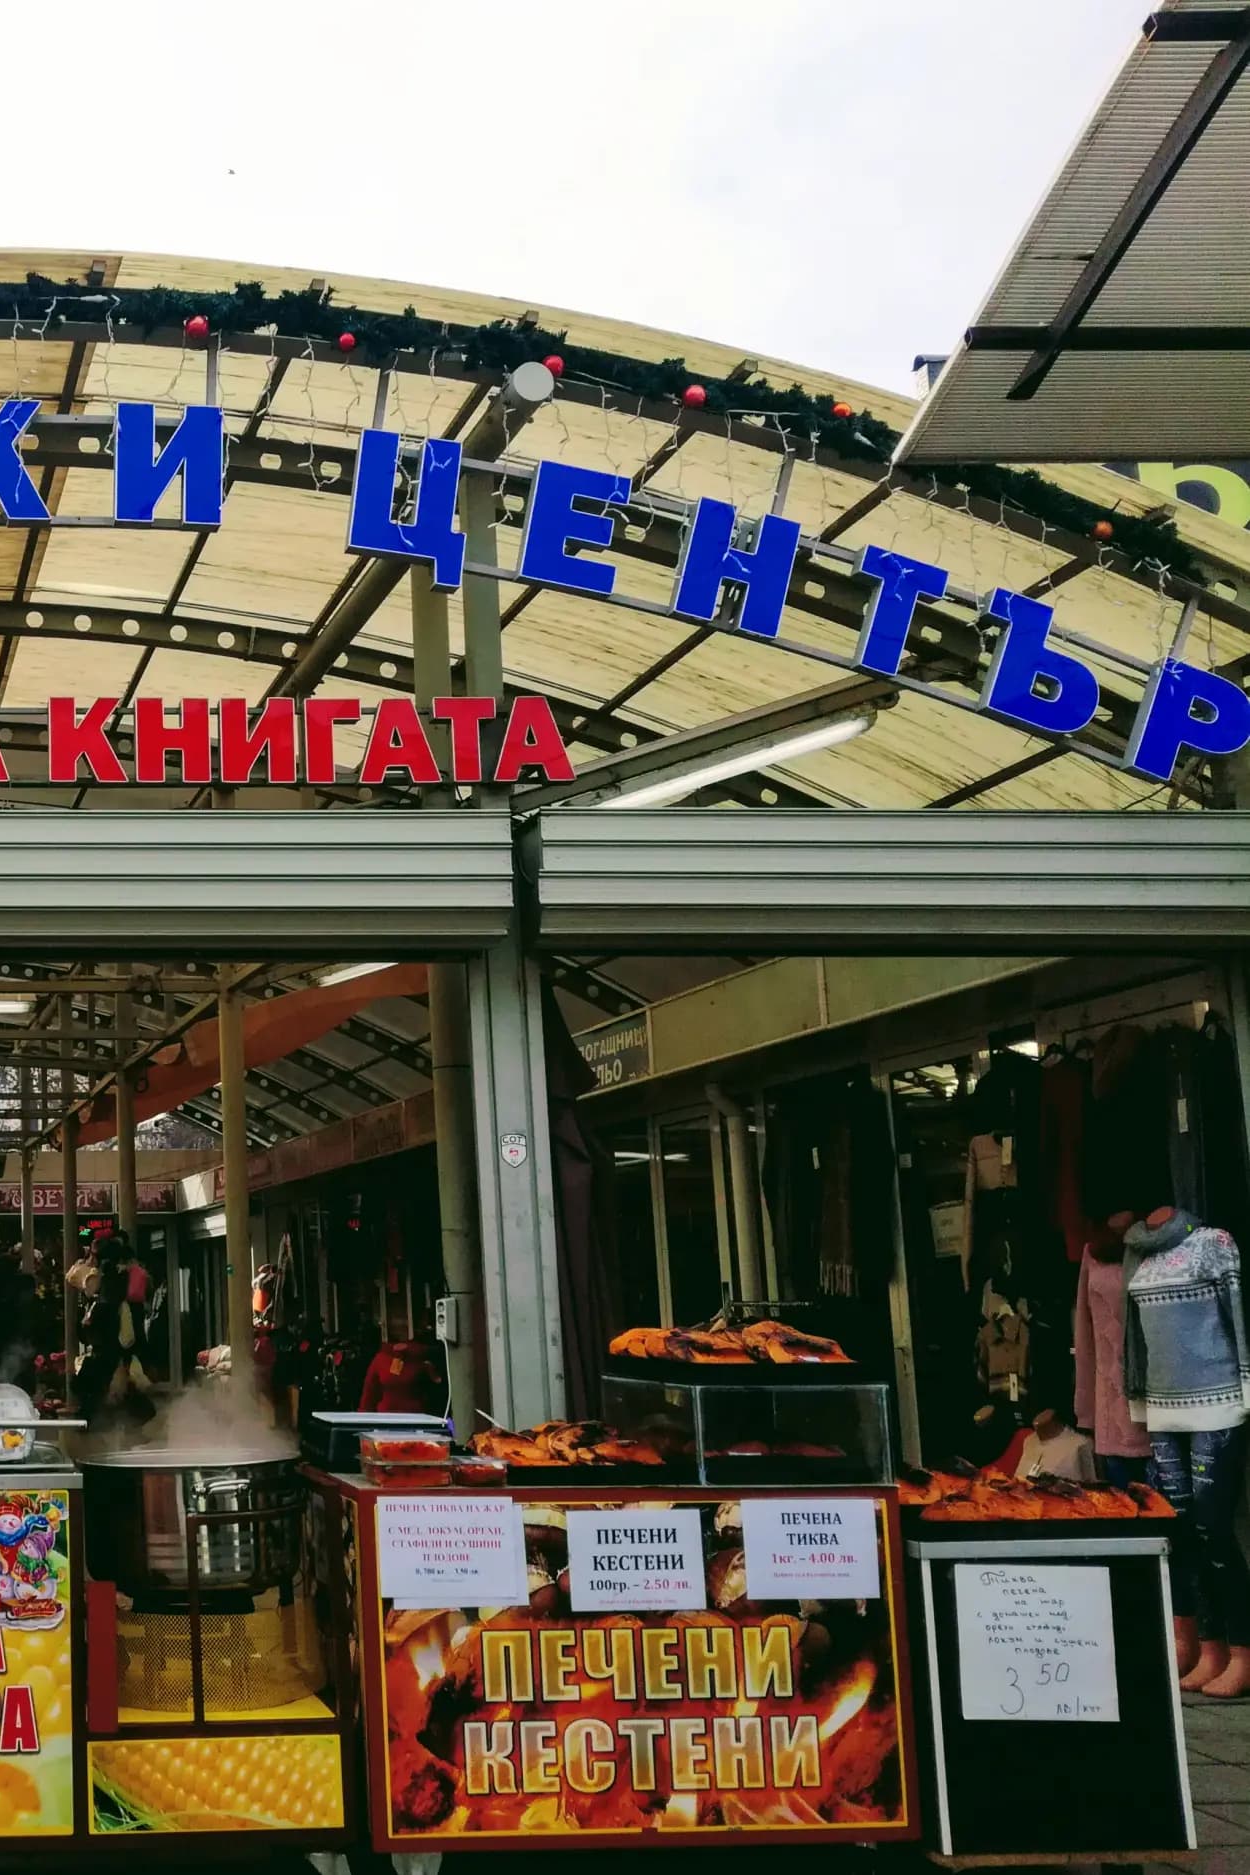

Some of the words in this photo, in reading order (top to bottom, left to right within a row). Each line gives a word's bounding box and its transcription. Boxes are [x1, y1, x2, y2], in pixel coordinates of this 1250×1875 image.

[349, 428, 1250, 782] ЦЕНТЪР
[48, 696, 577, 784] КНИГАТА
[780, 1512, 842, 1525] ПЕЧЕНА
[596, 1528, 678, 1545] ПЕЧЕНИ
[786, 1533, 839, 1545] ТИКВА
[592, 1554, 684, 1572] КЕСТЕНИ
[808, 1552, 836, 1564] 4.00
[589, 1579, 630, 1593] 100гр.
[643, 1578, 670, 1590] 2.50
[481, 1625, 794, 1703] ПЕЧЕНИ
[1000, 1667, 1025, 1715] 3
[1035, 1662, 1070, 1685] 50
[463, 1715, 822, 1796] КЕСТЕНИ
